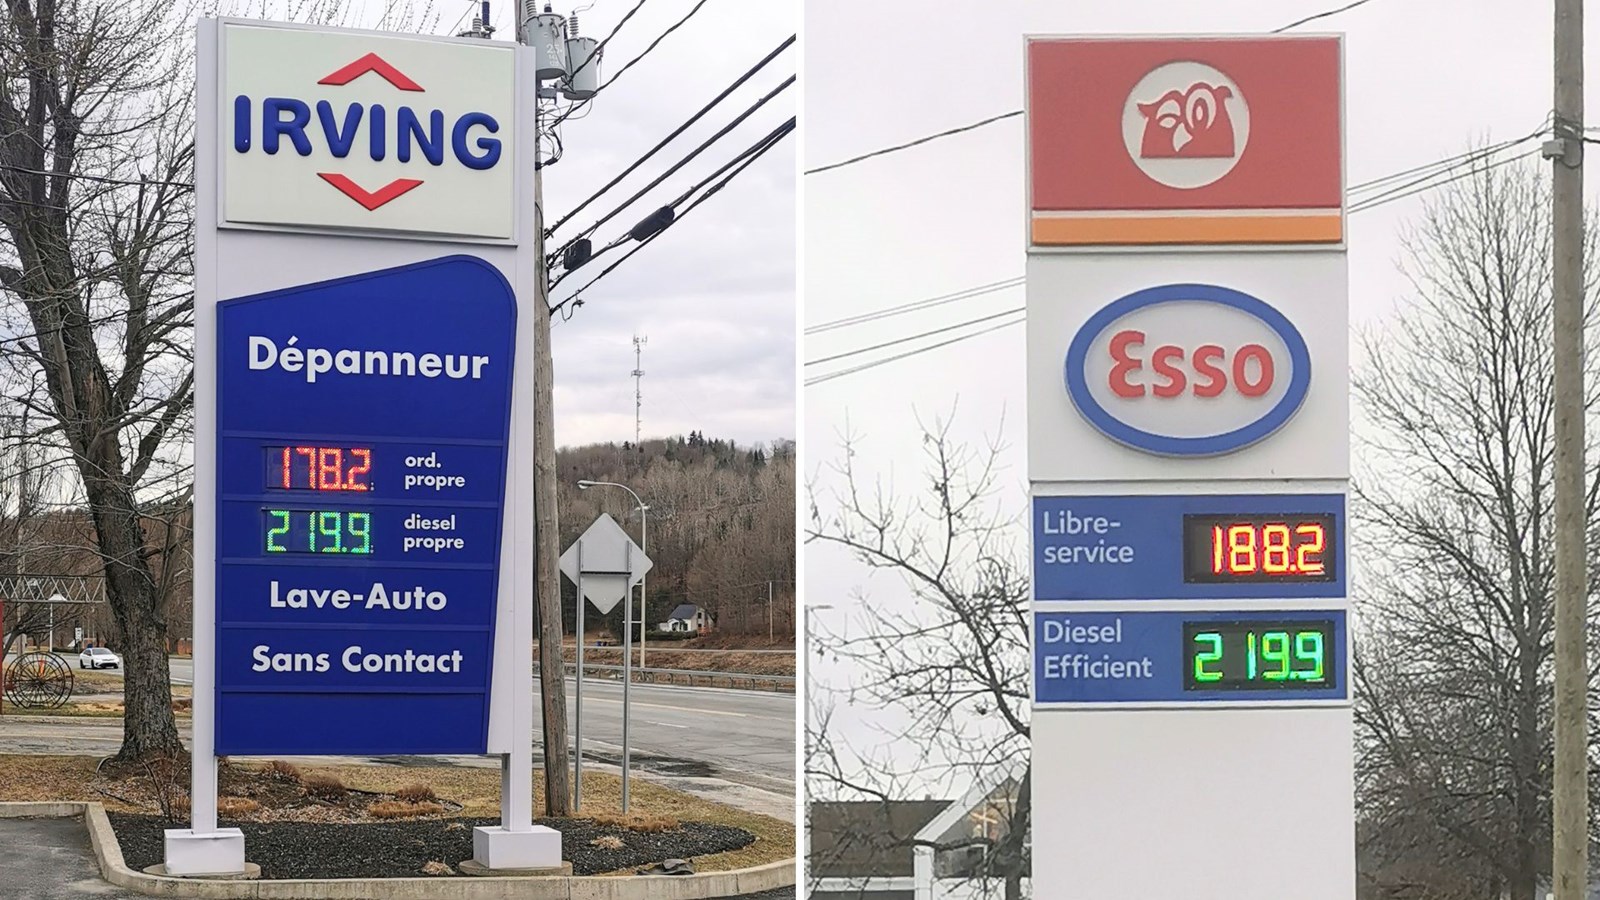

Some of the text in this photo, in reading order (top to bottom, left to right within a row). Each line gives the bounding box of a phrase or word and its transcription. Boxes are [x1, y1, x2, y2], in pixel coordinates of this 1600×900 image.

[234, 95, 502, 170] IRVING
[248, 335, 489, 383] Dépanneur
[1107, 329, 1275, 398] Esso
[282, 447, 371, 491] 178.2
[404, 452, 442, 468] ord.
[404, 472, 466, 490] propre
[267, 510, 370, 553] 219.9
[403, 513, 456, 531] diesel
[1043, 511, 1121, 535] Libre-
[403, 534, 465, 552] propre
[1043, 540, 1135, 564] service
[1212, 523, 1325, 575] 188.2
[270, 580, 447, 611] Lave-Auto
[1043, 618, 1122, 644] Diesel
[252, 645, 464, 673] Sans Contact
[1043, 656, 1153, 680] Efficient
[1194, 631, 1324, 682] 219.9
